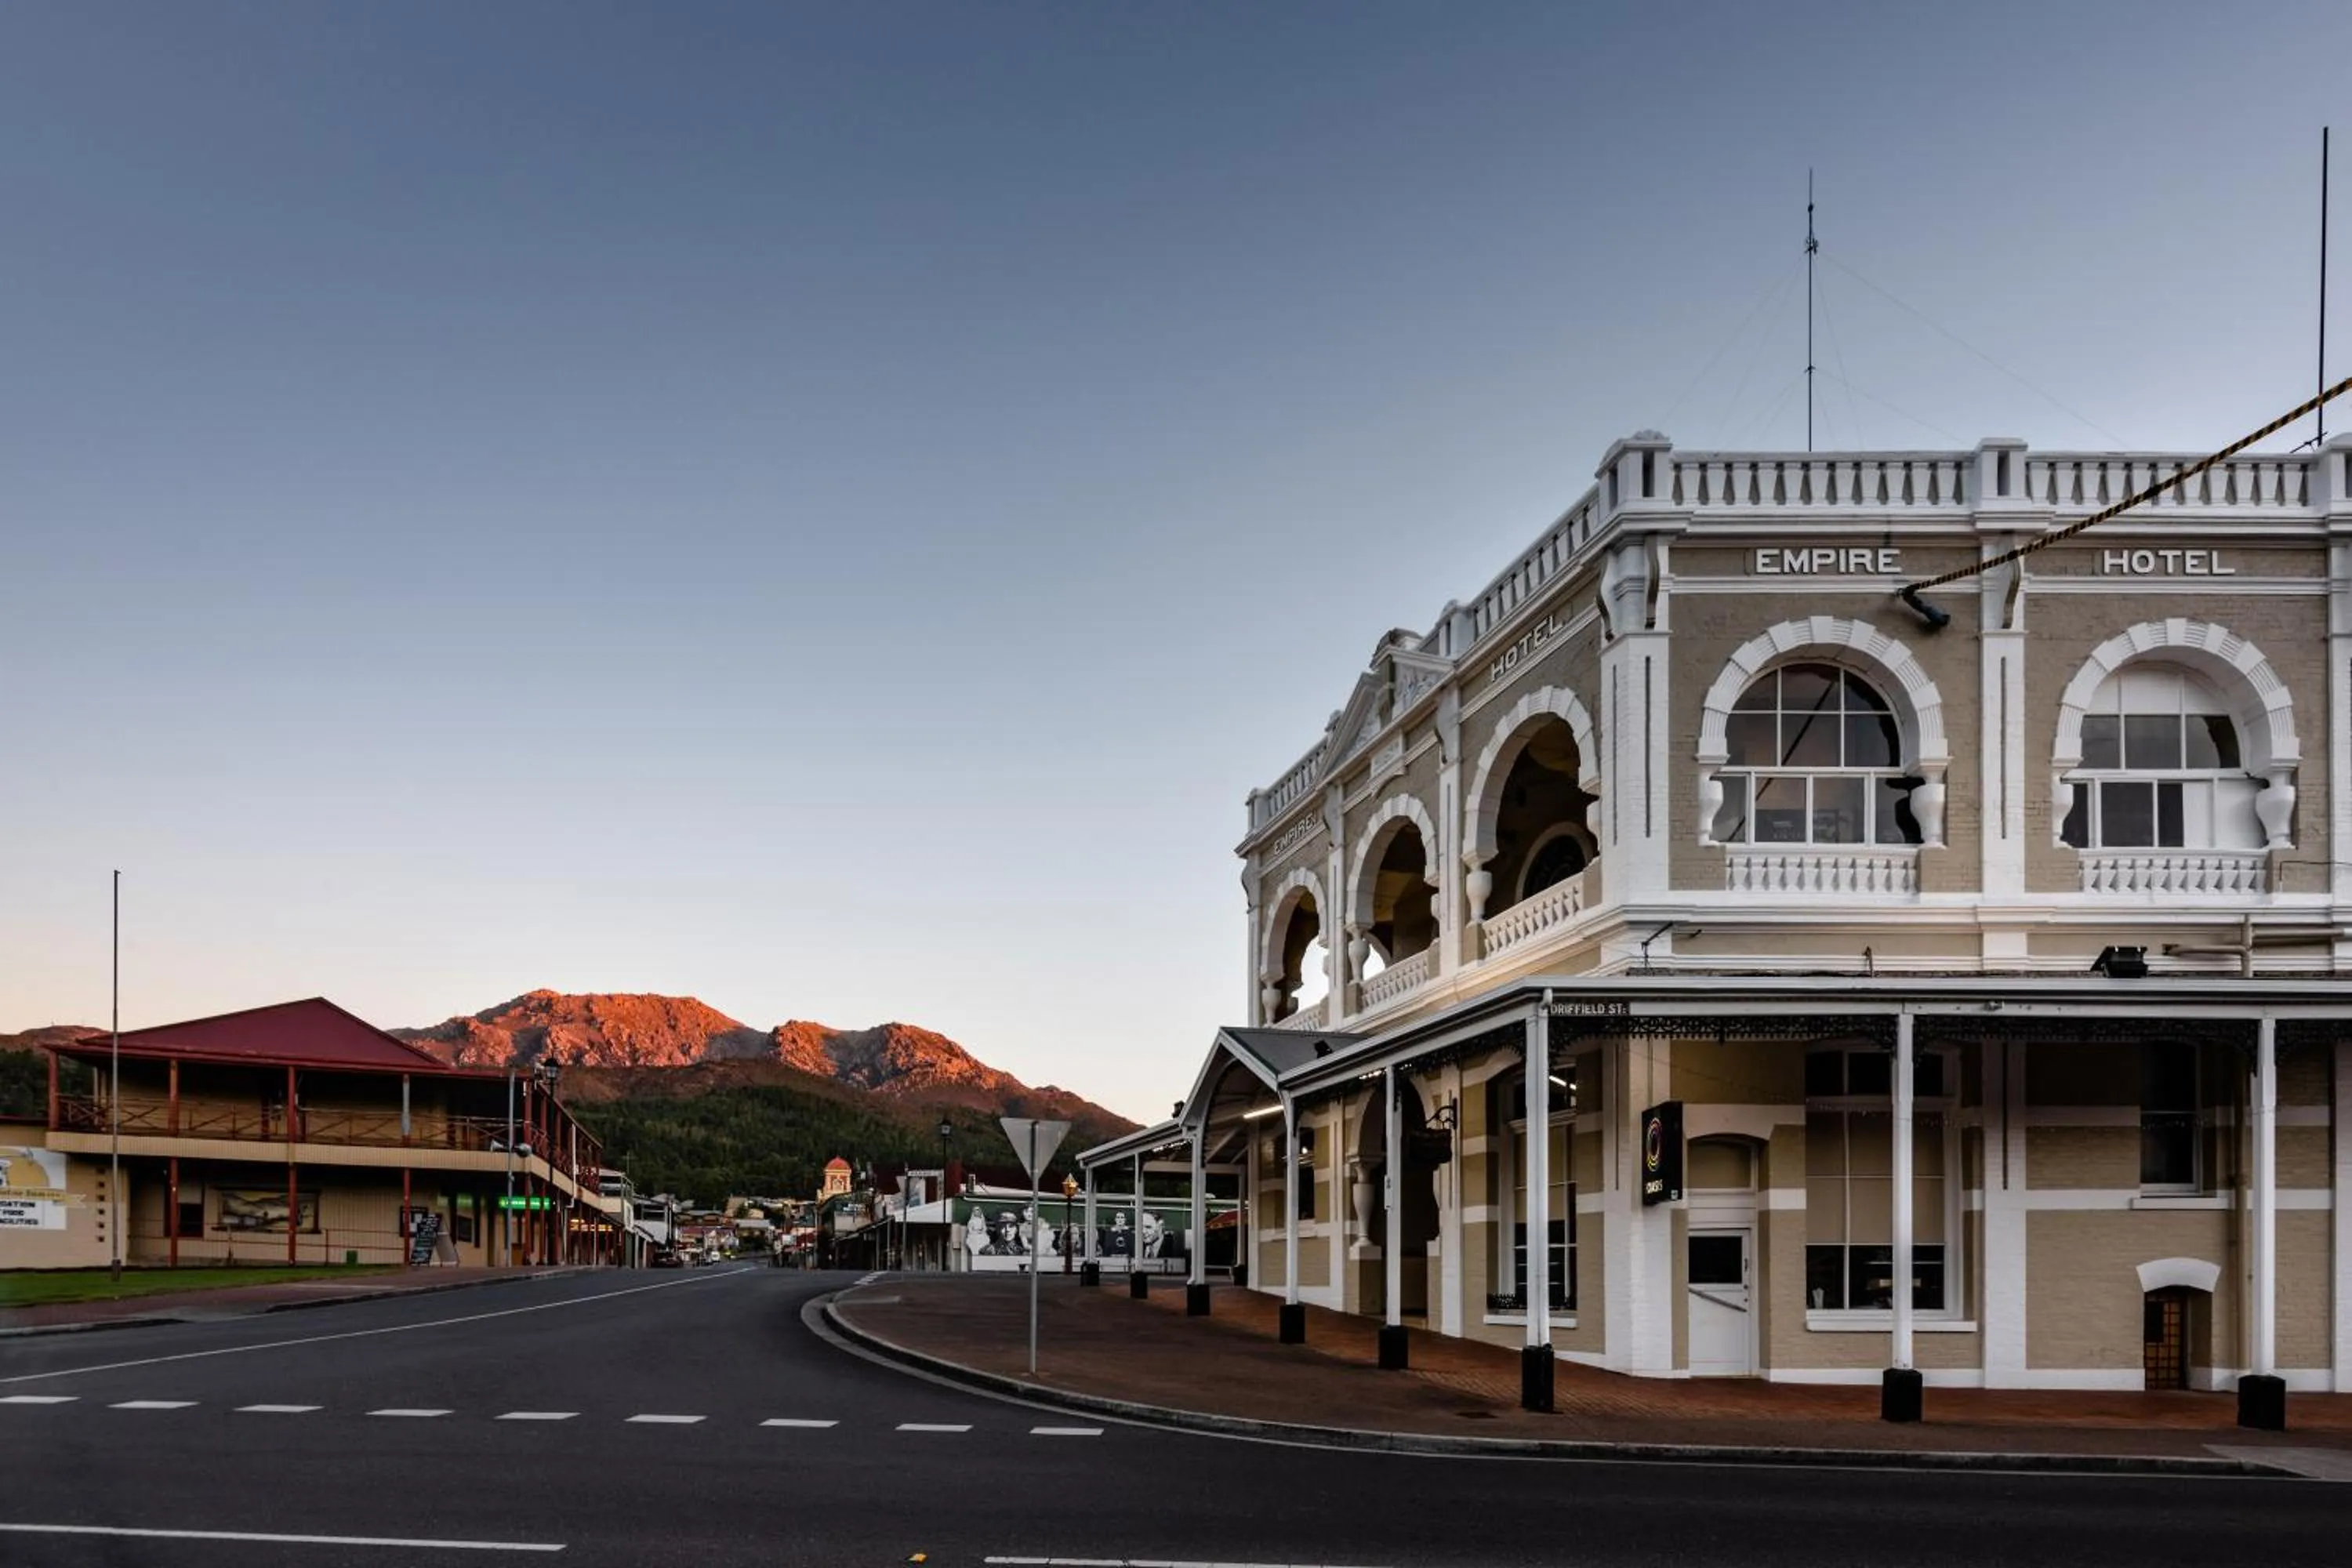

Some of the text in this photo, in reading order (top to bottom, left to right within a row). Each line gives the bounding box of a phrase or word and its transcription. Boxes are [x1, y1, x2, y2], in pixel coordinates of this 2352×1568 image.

[1756, 549, 2235, 574] EMPIRE HOTEL
[1491, 615, 1563, 682] HOTEL
[1274, 812, 1315, 855] EMPIRE
[1551, 1003, 1605, 1014] DRIFFIELD
